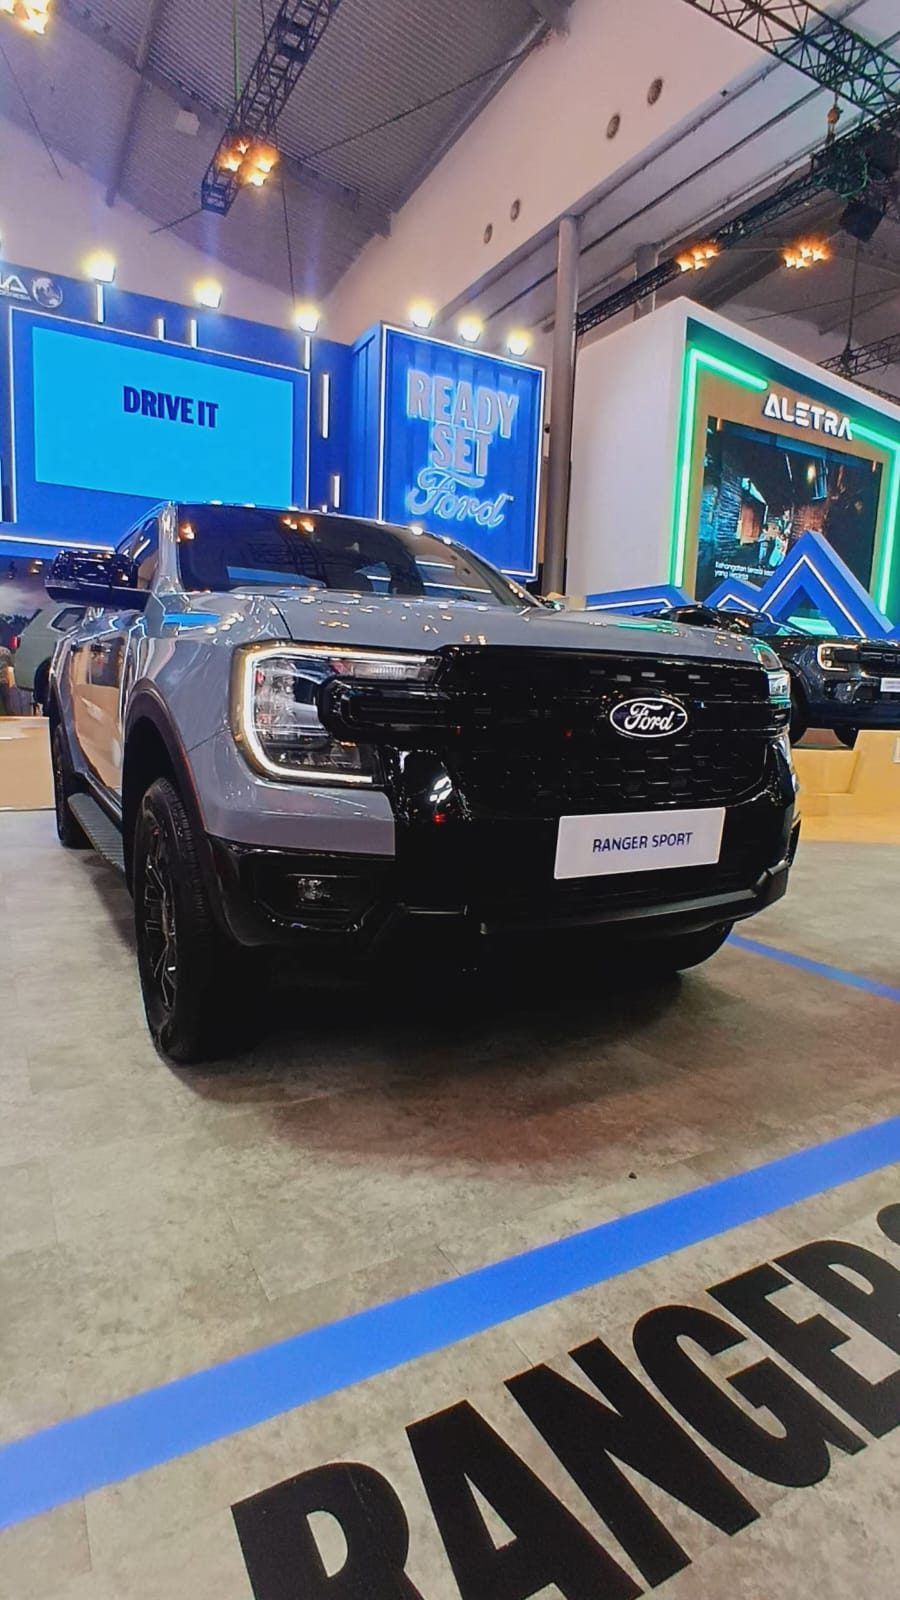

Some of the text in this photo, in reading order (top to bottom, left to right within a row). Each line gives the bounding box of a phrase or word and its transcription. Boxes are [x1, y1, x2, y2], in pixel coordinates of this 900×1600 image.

[123, 385, 219, 428] DRIVE IT
[406, 368, 519, 438] READY
[764, 393, 853, 441] ALETRA
[431, 422, 493, 477] SET
[406, 466, 513, 527] Ford
[624, 703, 674, 730] Ford
[592, 832, 694, 853] RANGER SPORT
